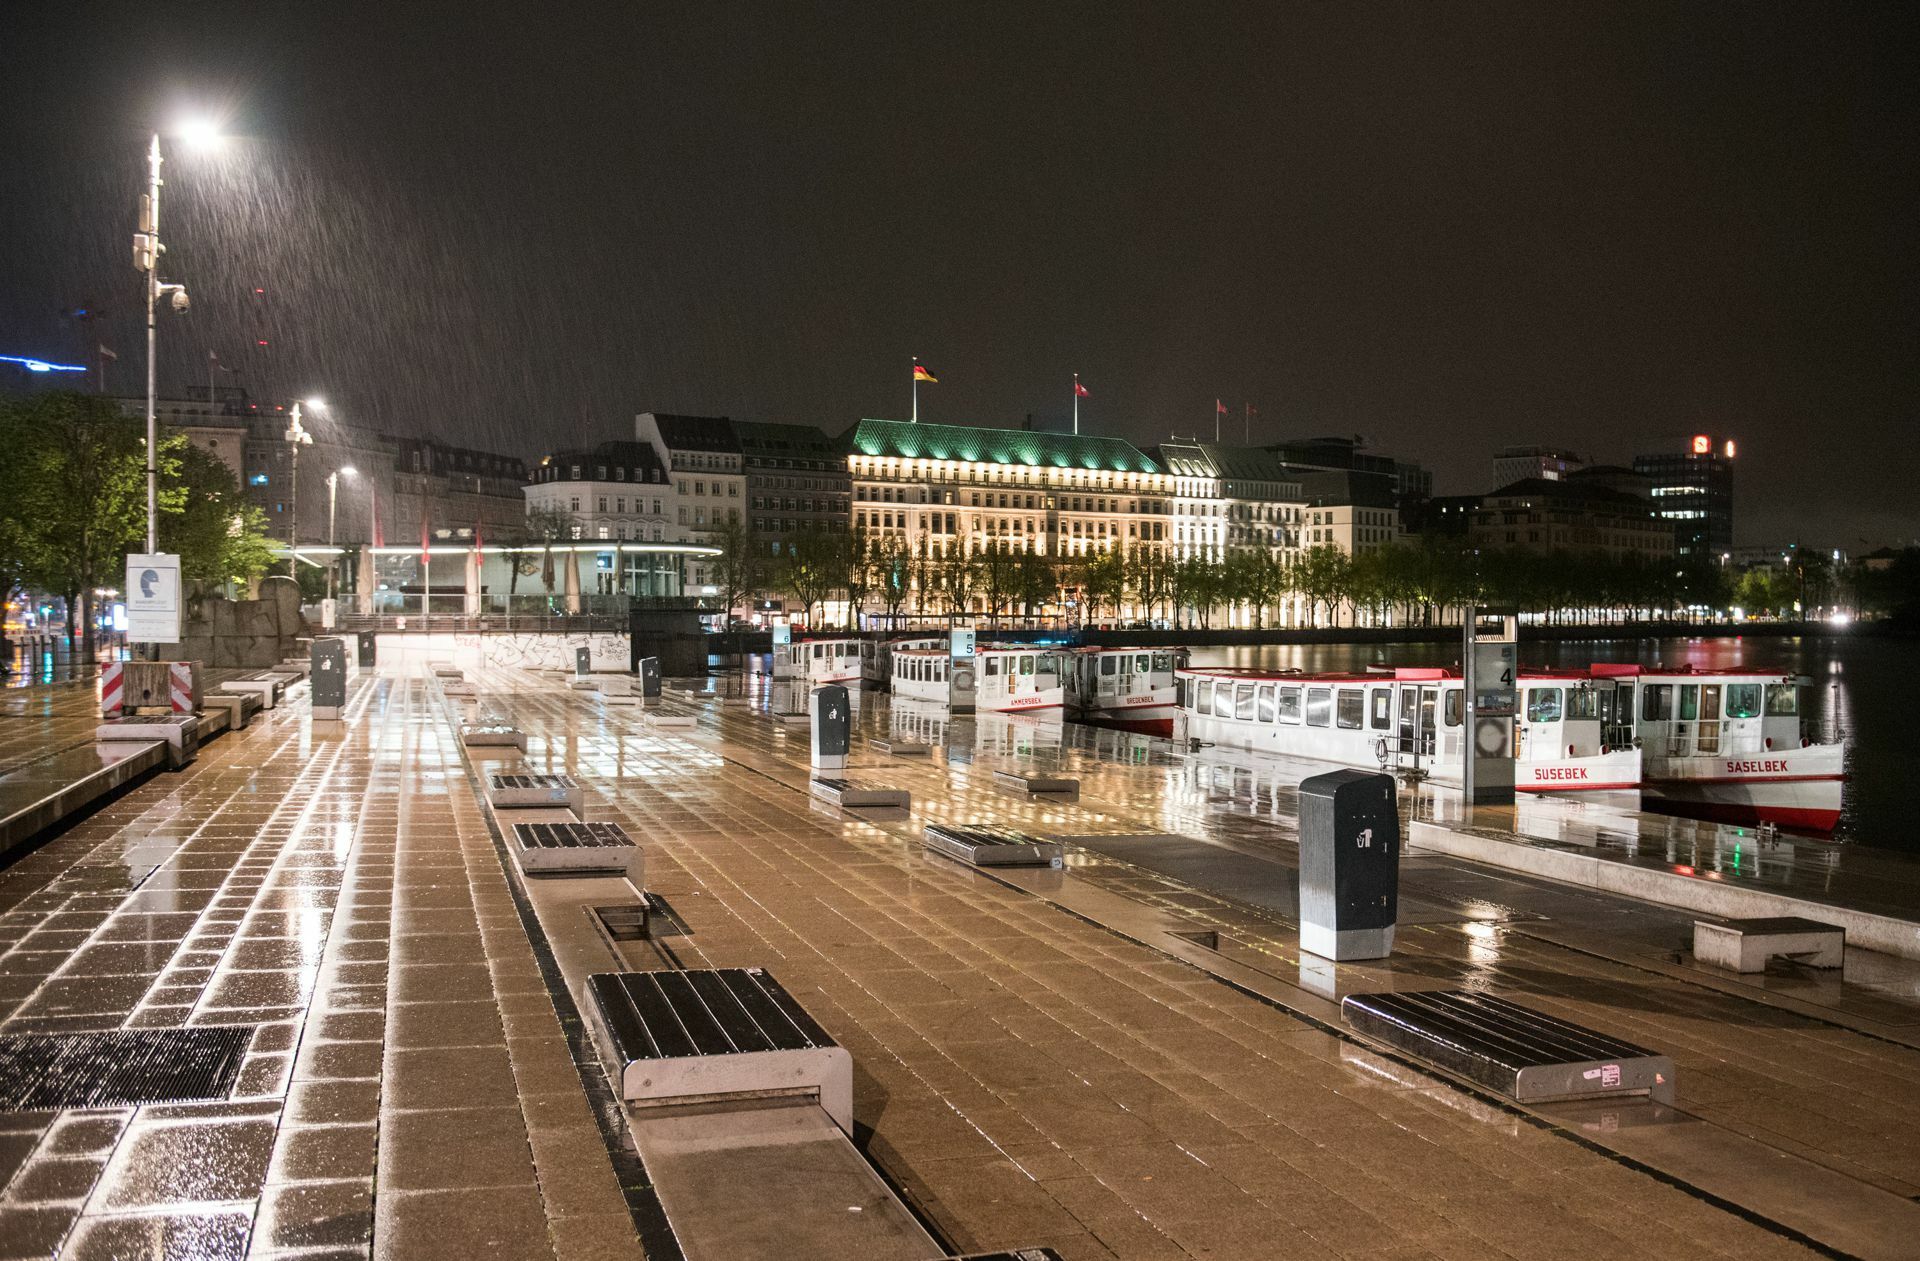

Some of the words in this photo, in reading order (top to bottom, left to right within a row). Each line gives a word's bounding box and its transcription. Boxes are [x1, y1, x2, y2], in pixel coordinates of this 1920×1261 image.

[966, 644, 974, 654] 5
[1500, 668, 1513, 686] 4
[1011, 697, 1042, 706] AMMERSBEK
[1727, 760, 1789, 773] SASELBEK
[1534, 767, 1588, 780] SUSEBEK
